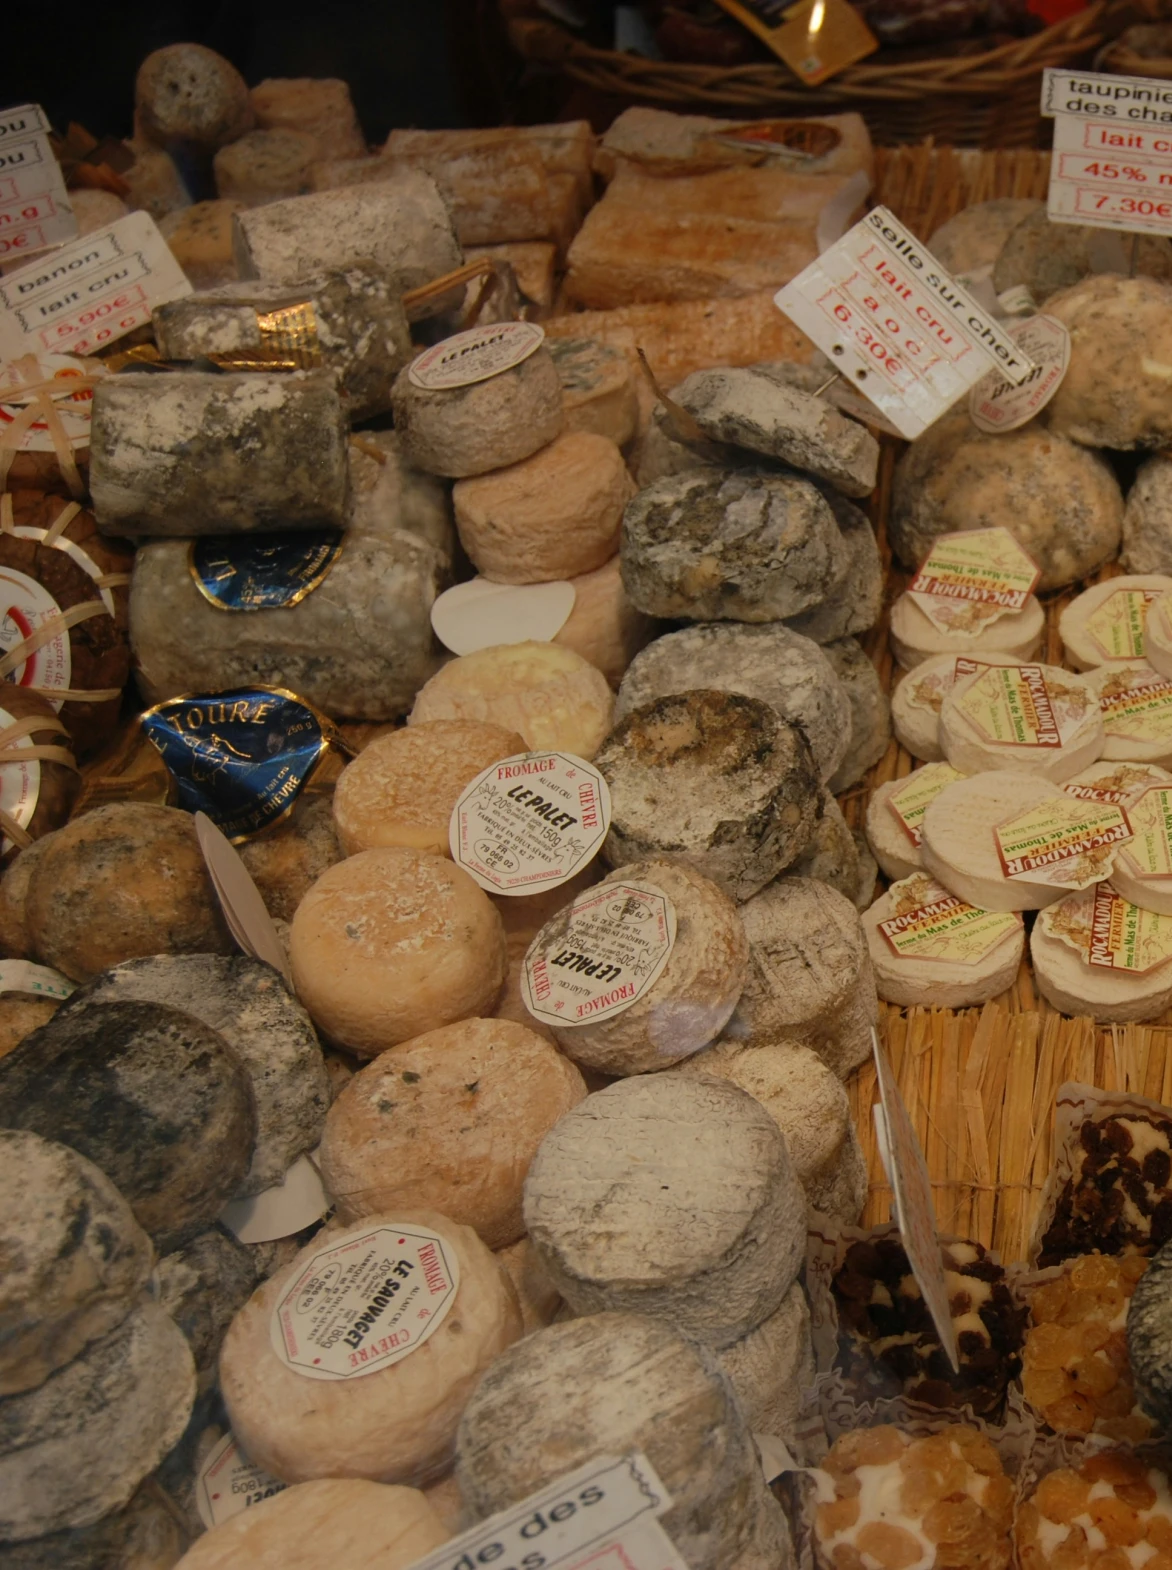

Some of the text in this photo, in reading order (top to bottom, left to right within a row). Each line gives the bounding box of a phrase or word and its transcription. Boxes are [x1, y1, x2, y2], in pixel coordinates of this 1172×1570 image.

[1066, 98, 1117, 116] des
[1101, 131, 1143, 148] lait
[1084, 163, 1146, 182] 45%
[18, 251, 100, 293] banon
[39, 269, 129, 316] lait cru
[869, 214, 924, 270] selle
[926, 272, 965, 310] sur
[968, 317, 1020, 369] cher
[875, 261, 953, 344] lait cru
[833, 304, 903, 376] 6.30€
[863, 296, 921, 356] a o c
[441, 354, 458, 364] LE
[461, 333, 505, 356] PALET
[913, 575, 1027, 608] ROCAMADOUR
[942, 574, 1007, 590] FERMIER
[1021, 668, 1059, 744] ROCAMADOUR
[1013, 716, 1026, 742] Thomas
[497, 759, 598, 830] FROMAGE de CHÈVRE
[539, 777, 572, 800] AU LAIT CRU
[493, 796, 562, 848] 20% 150g
[507, 784, 578, 831] LE PALET
[477, 812, 507, 833] FABRIQUÉ
[506, 829, 515, 837] EN
[515, 835, 552, 863] DEUX-SÈVRES
[480, 843, 514, 869] 79 02
[496, 843, 508, 855] FR
[1004, 824, 1089, 853] Mas de Thomas
[1007, 824, 1131, 874] ROCAMADOUR
[1031, 828, 1100, 855] FERMIER
[485, 857, 497, 868] CE
[925, 916, 963, 935] Mas de
[1111, 902, 1124, 950] FERMIER
[1124, 920, 1136, 947] Mas de
[551, 950, 622, 983] LE PALET
[532, 958, 636, 1018] FROMAGE CHÈVRE
[301, 1277, 320, 1296] CEE
[351, 1250, 376, 1286] FABRIQUÉ
[393, 1260, 414, 1279] LE
[302, 1269, 335, 1308] 79 02
[320, 1258, 396, 1349] 20% 180g
[348, 1242, 448, 1367] FROMAGE CHÈVRE
[410, 1286, 421, 1296] AU
[307, 1295, 344, 1341] DEUX-SÈVRES
[343, 1278, 401, 1350] SAUVAGET
[519, 1486, 605, 1539] des
